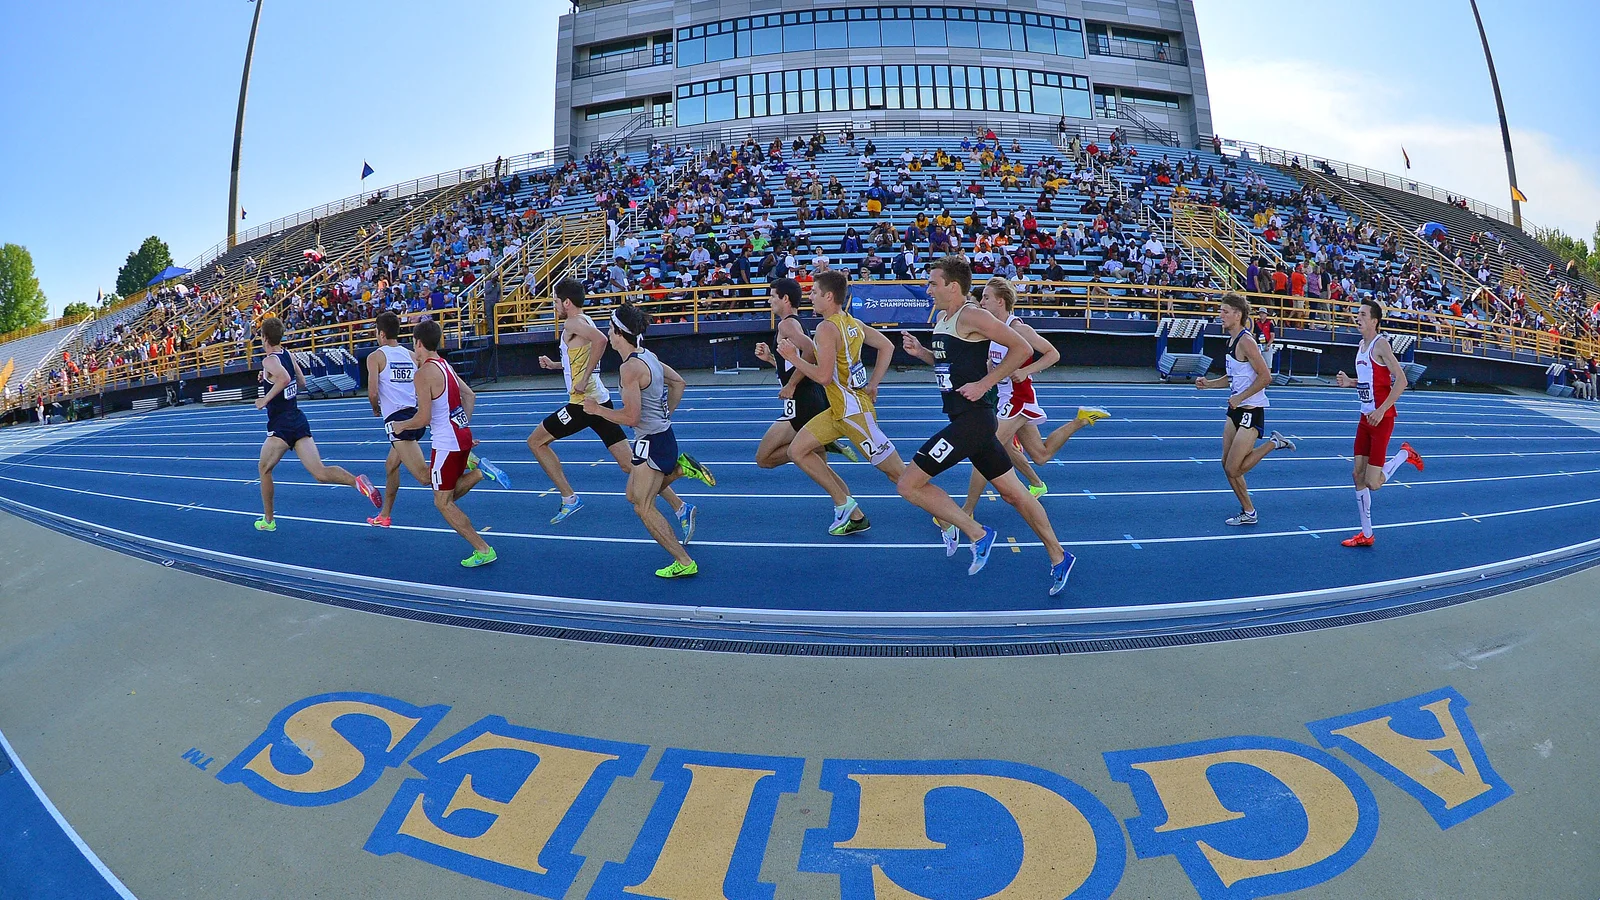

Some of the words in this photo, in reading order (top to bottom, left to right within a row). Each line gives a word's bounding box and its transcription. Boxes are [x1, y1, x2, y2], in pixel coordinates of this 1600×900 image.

[1462, 339, 1472, 351] 30
[392, 369, 411, 379] 1662
[786, 400, 794, 415] 8
[1001, 403, 1011, 416] 5
[559, 410, 569, 422] 12
[1242, 413, 1250, 425] 9
[638, 441, 647, 456] 7
[862, 441, 876, 456] 2
[932, 441, 948, 459] 3
[433, 470, 439, 484] 1
[180, 747, 216, 771] TM
[216, 686, 1514, 900] AGGIES
